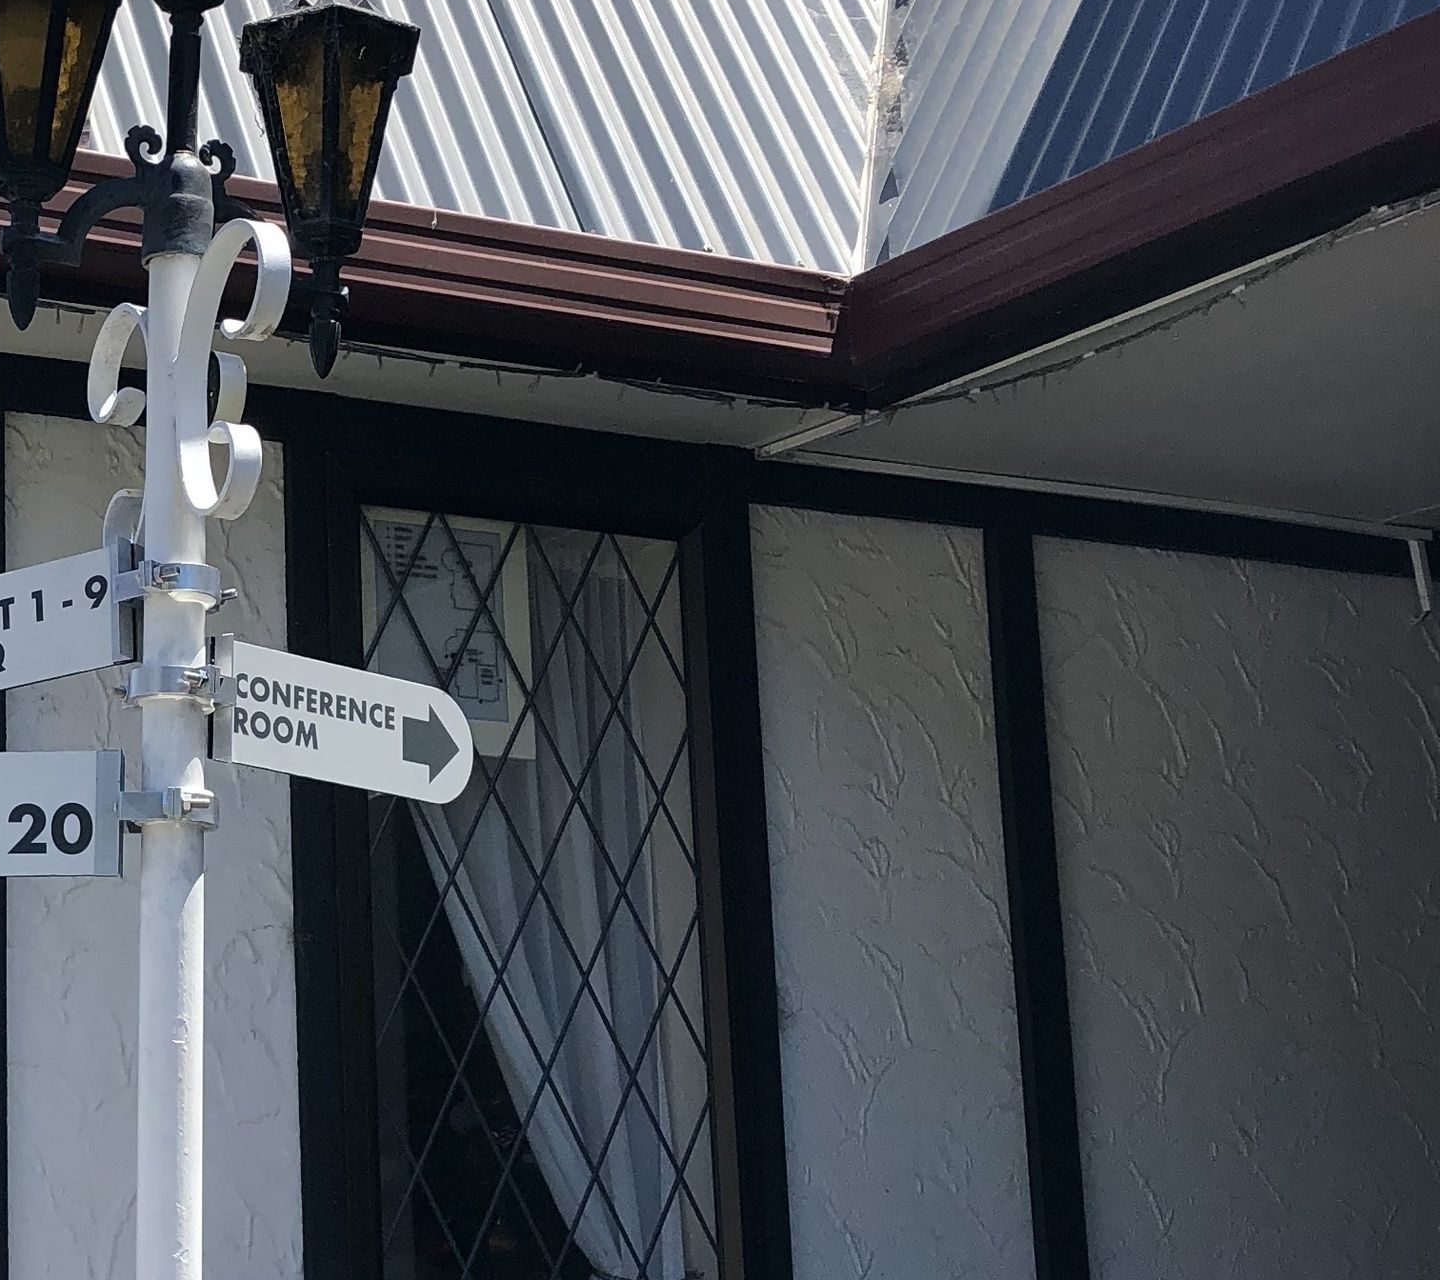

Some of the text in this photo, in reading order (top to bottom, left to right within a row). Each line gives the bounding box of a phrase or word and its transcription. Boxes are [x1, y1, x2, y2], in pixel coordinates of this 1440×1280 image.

[31, 589, 45, 623] 1
[84, 574, 109, 610] 9
[236, 672, 396, 731] CONFERENCE
[233, 706, 319, 751] ROOM
[7, 802, 94, 856] 20
